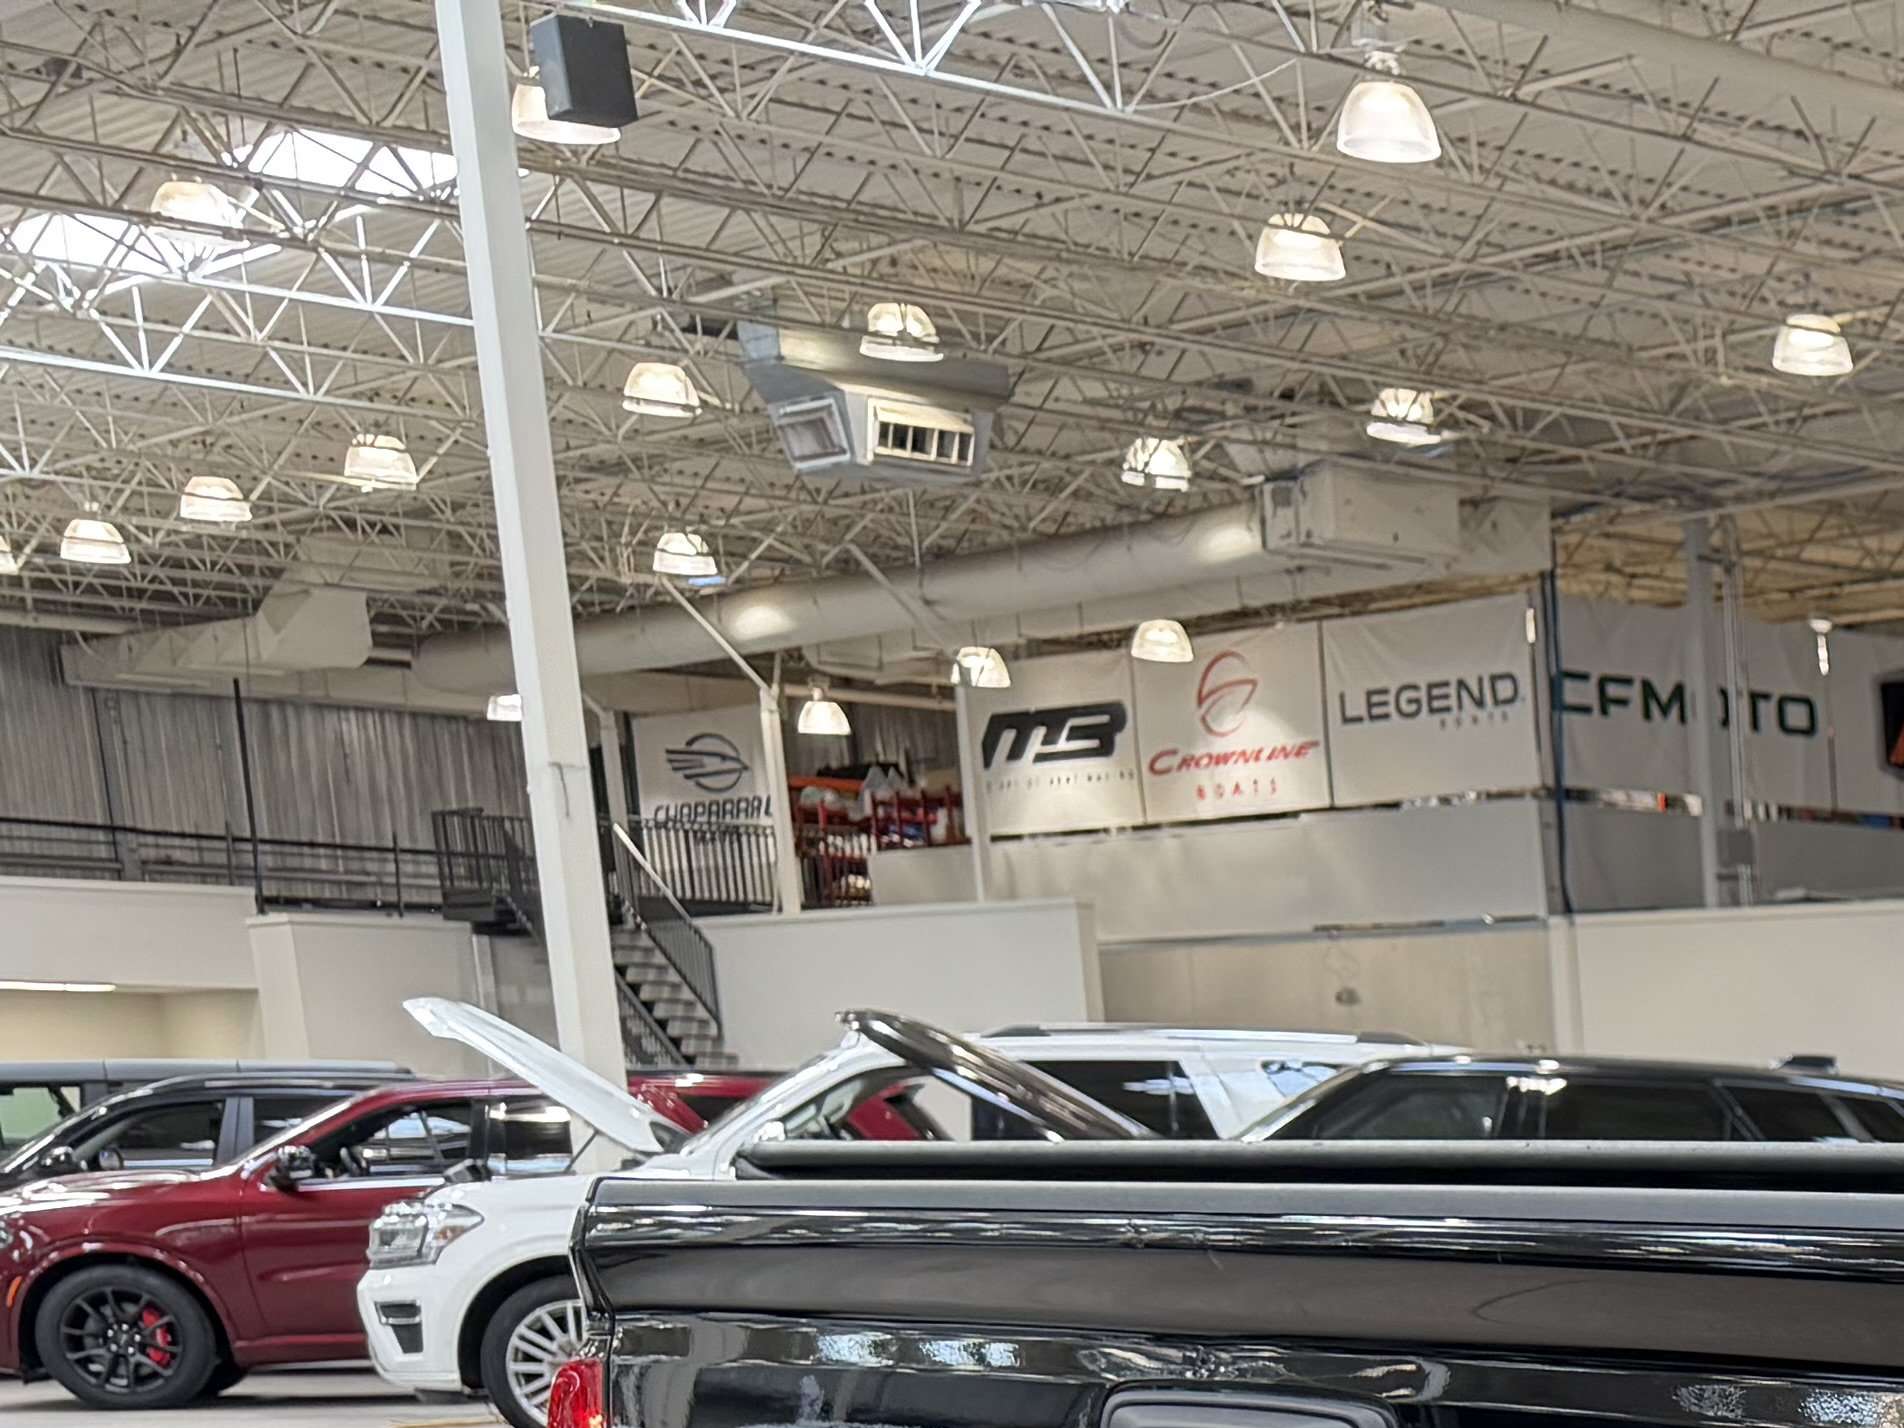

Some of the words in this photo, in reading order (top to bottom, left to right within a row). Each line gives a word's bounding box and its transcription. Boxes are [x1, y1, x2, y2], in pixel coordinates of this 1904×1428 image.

[1338, 670, 1520, 726] LEGEND
[1553, 669, 1818, 737] CFMTO
[1147, 739, 1321, 777] CROWNLINE
